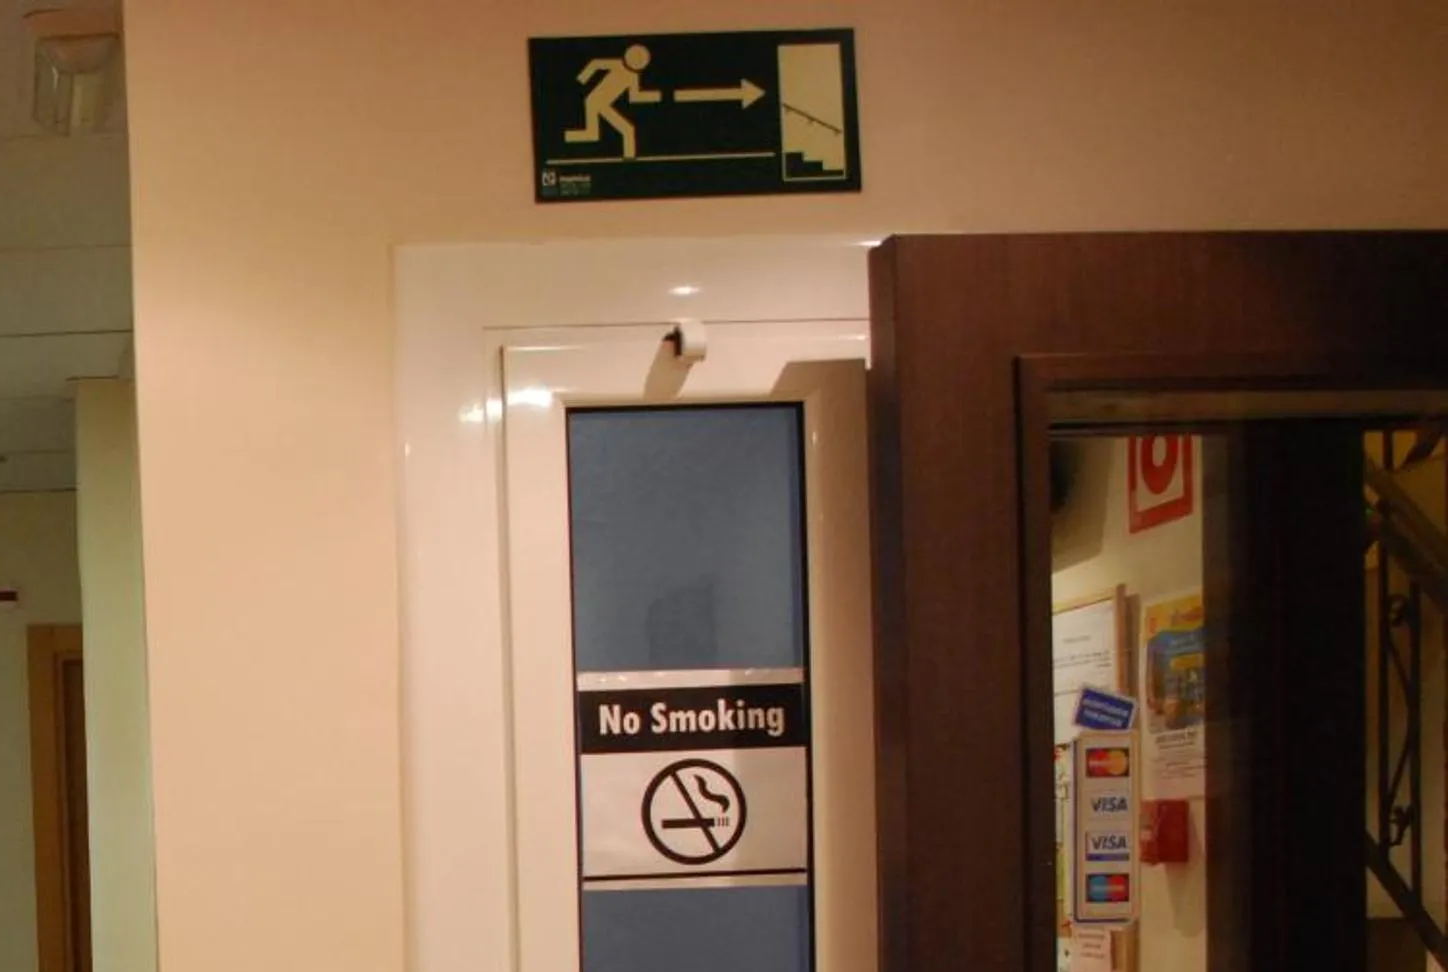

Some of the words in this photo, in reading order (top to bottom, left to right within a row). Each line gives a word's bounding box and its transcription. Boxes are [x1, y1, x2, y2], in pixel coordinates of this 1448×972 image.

[599, 703, 640, 735] No
[651, 698, 785, 737] Smoking
[1091, 796, 1128, 813] VISA
[1091, 834, 1127, 850] VISA
